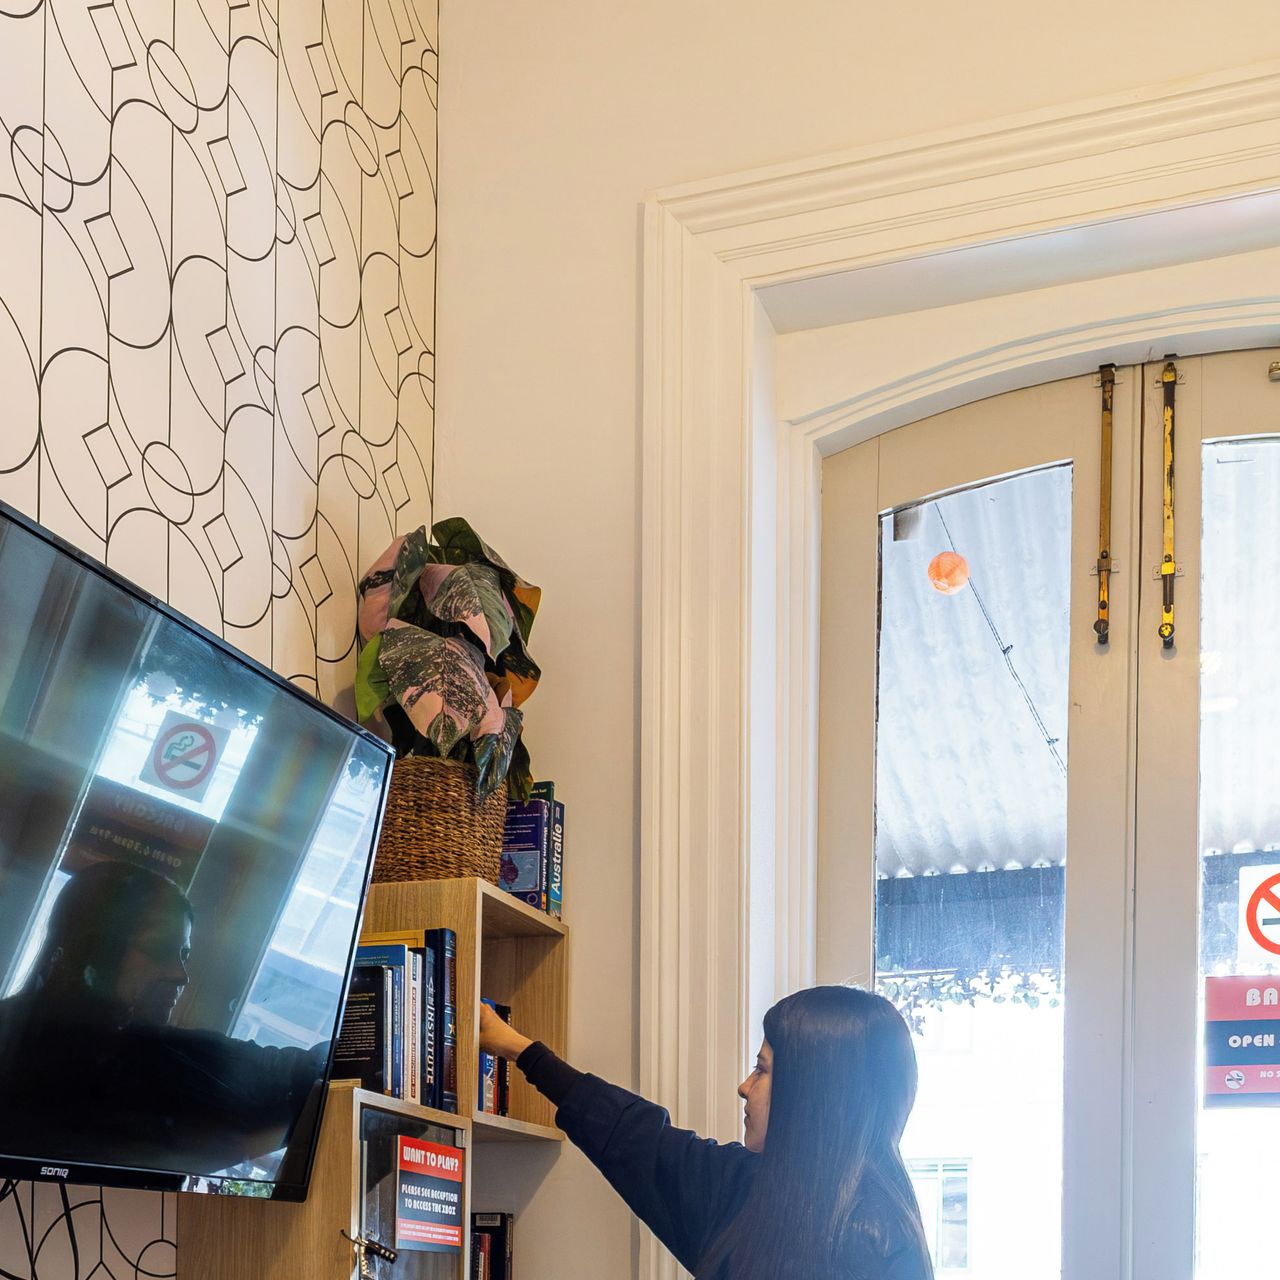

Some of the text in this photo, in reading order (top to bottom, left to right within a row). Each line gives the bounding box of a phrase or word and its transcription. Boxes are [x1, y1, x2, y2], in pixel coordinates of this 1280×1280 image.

[426, 1005, 436, 1085] INSTITUTE
[1228, 1032, 1275, 1048] OPEN
[1259, 1070, 1274, 1078] NO
[403, 1146, 459, 1172] WANT TO PLAY?
[40, 1166, 69, 1179] SONIQ
[401, 1183, 458, 1203] PLEASE SEE RECEPTION
[404, 1198, 457, 1216] TO ACCESS THE XBOX
